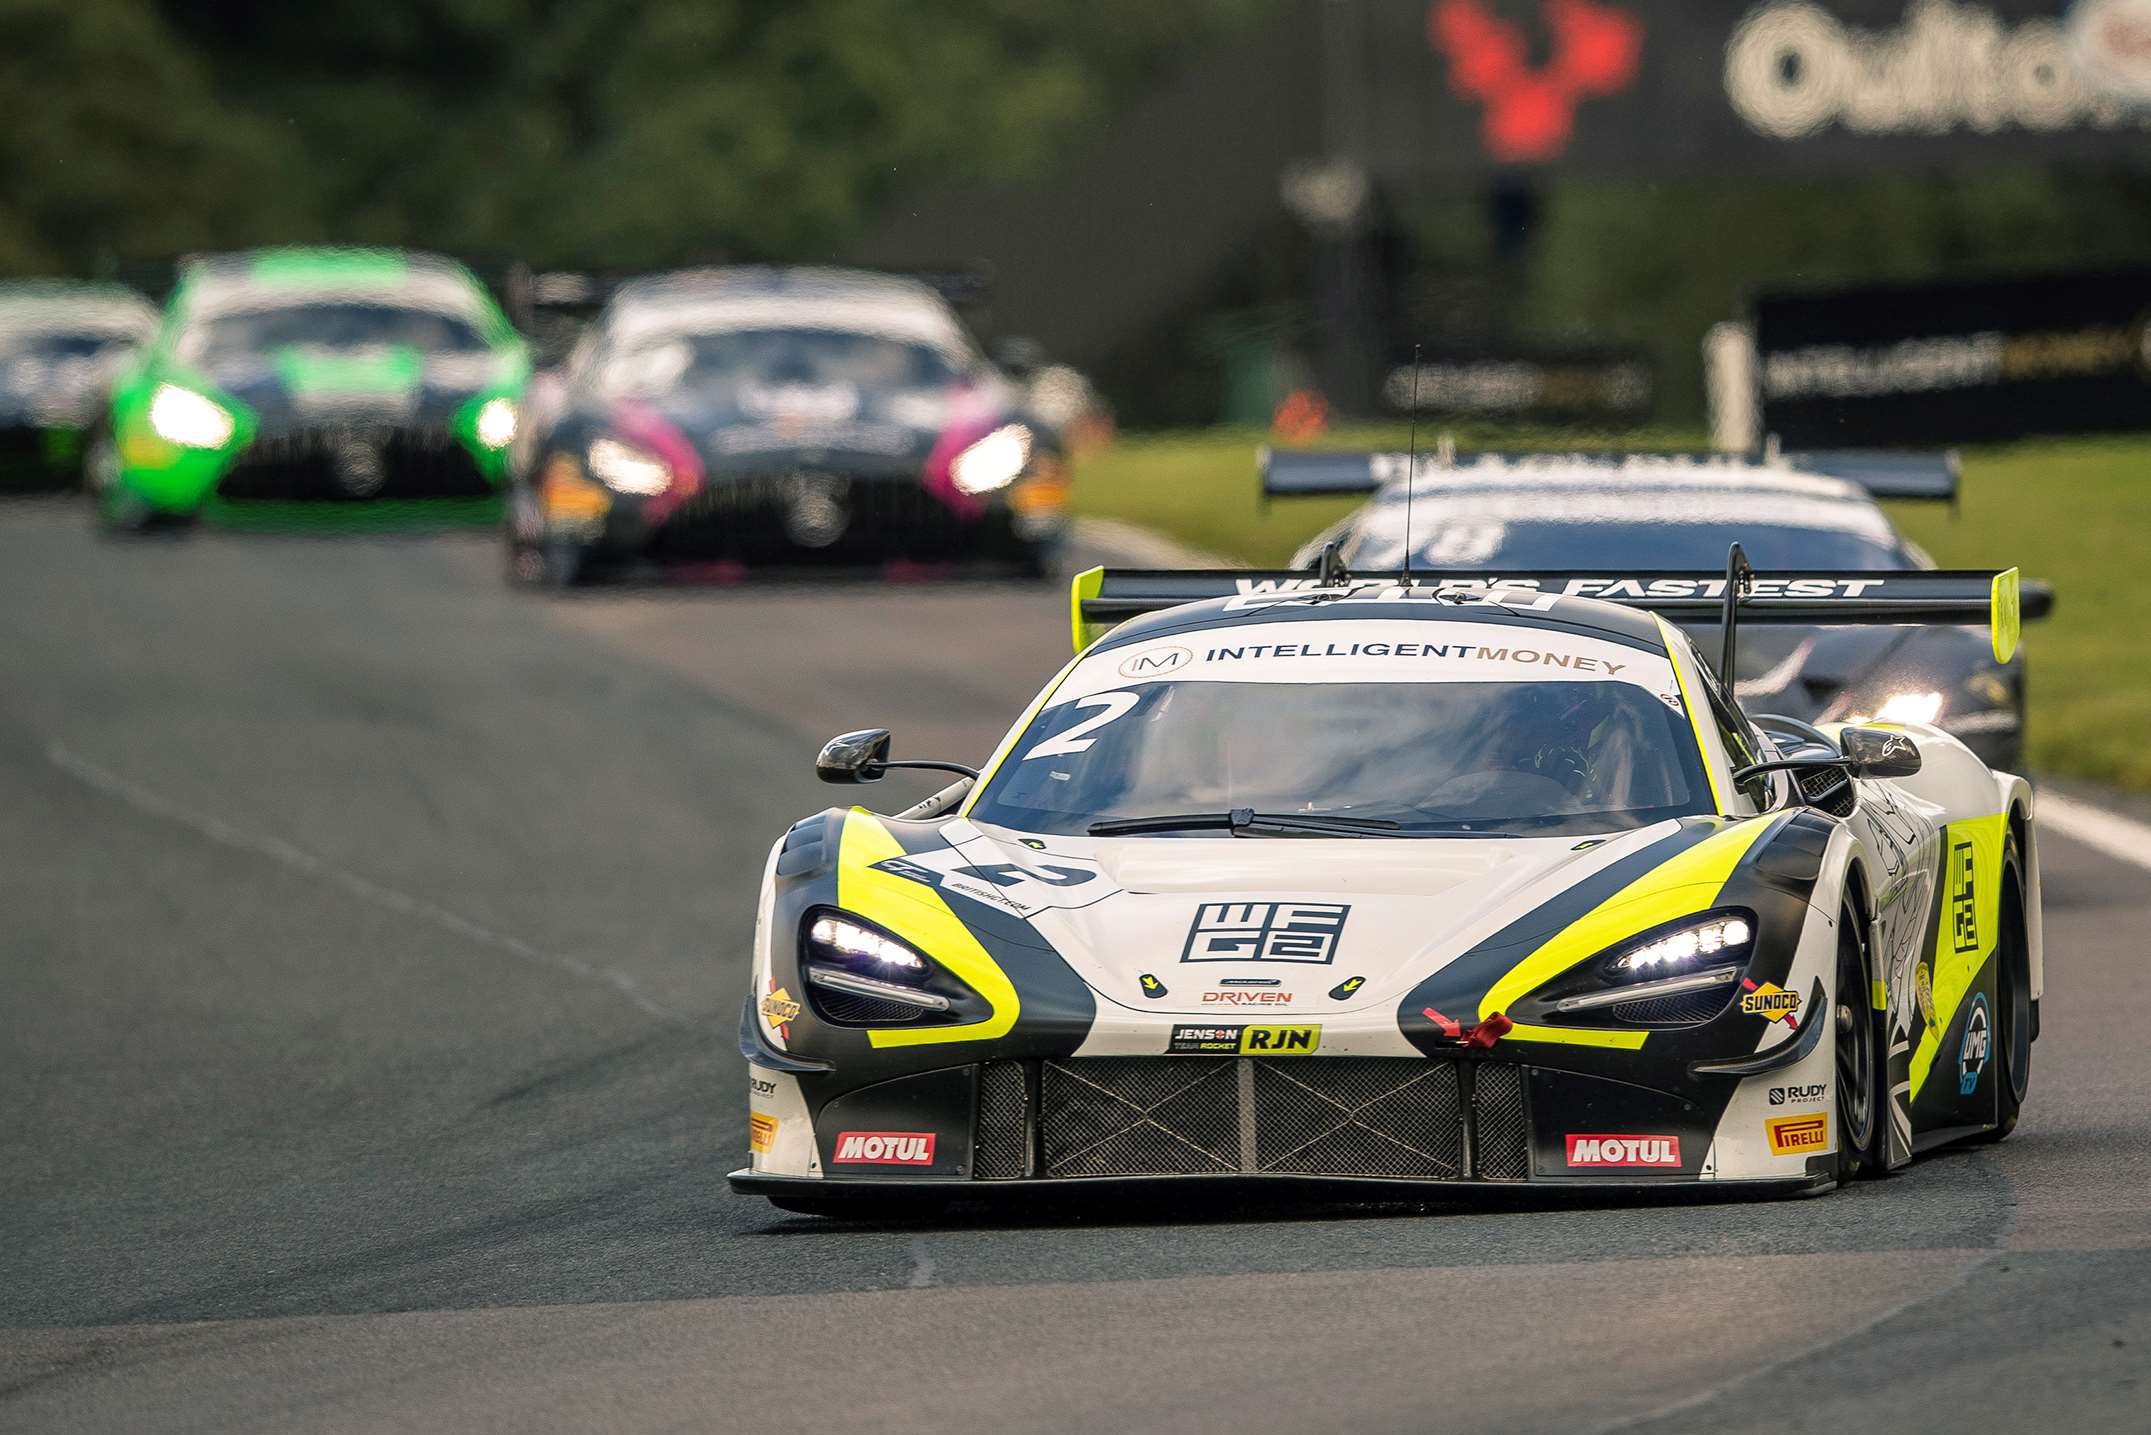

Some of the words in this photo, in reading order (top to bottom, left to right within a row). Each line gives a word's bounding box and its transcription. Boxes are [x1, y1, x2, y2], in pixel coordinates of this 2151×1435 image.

[1722, 0, 2128, 140] Oulto
[1561, 579, 1884, 598] FASTEST
[1205, 643, 1626, 676] INTELLIGENTMONEY
[1022, 691, 1141, 761] 2
[1202, 992, 1293, 1005] DRIVEN
[1745, 993, 1797, 1012] SUNOCO
[1248, 1030, 1312, 1049] RJN
[1788, 1084, 1827, 1098] RUDY
[1773, 1119, 1825, 1148] PIRELLI
[838, 1136, 929, 1161] MOTUL
[1572, 1139, 1676, 1162] MOTUL
